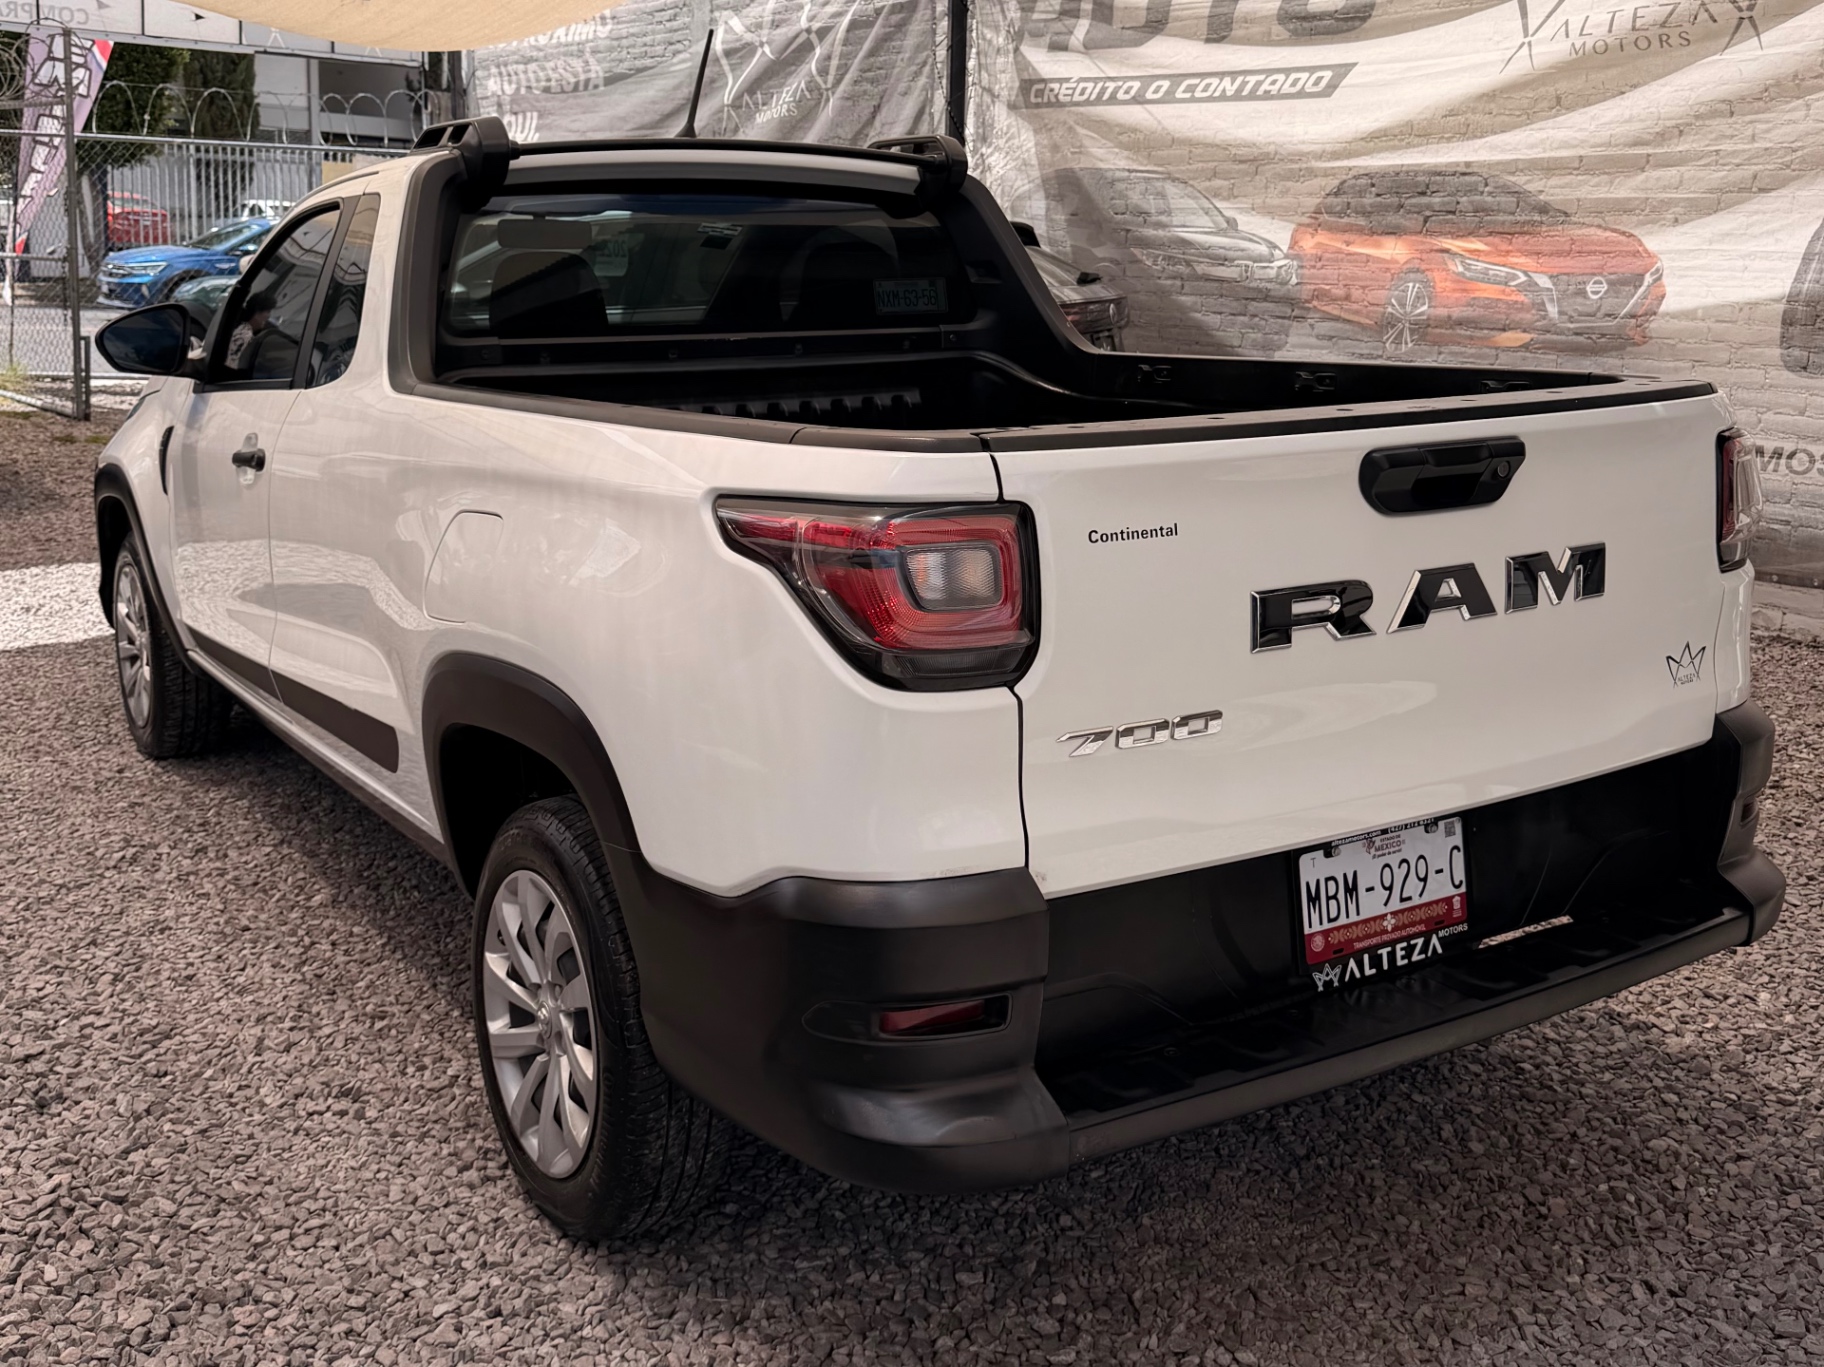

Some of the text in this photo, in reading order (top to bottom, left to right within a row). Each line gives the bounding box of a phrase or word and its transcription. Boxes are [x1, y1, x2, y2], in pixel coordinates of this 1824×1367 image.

[1550, 0, 1718, 41] ALTEZA
[1569, 31, 1692, 57] MOTORS
[1030, 70, 1333, 103] CRÉDITO O CONTADO
[1087, 522, 1179, 545] Continental
[1250, 541, 1607, 655] RAM
[1056, 709, 1224, 758] 700
[1310, 857, 1317, 869] T
[1305, 845, 1464, 929] MBM-929-C
[1345, 923, 1469, 982] ALTEZA MOTORS
